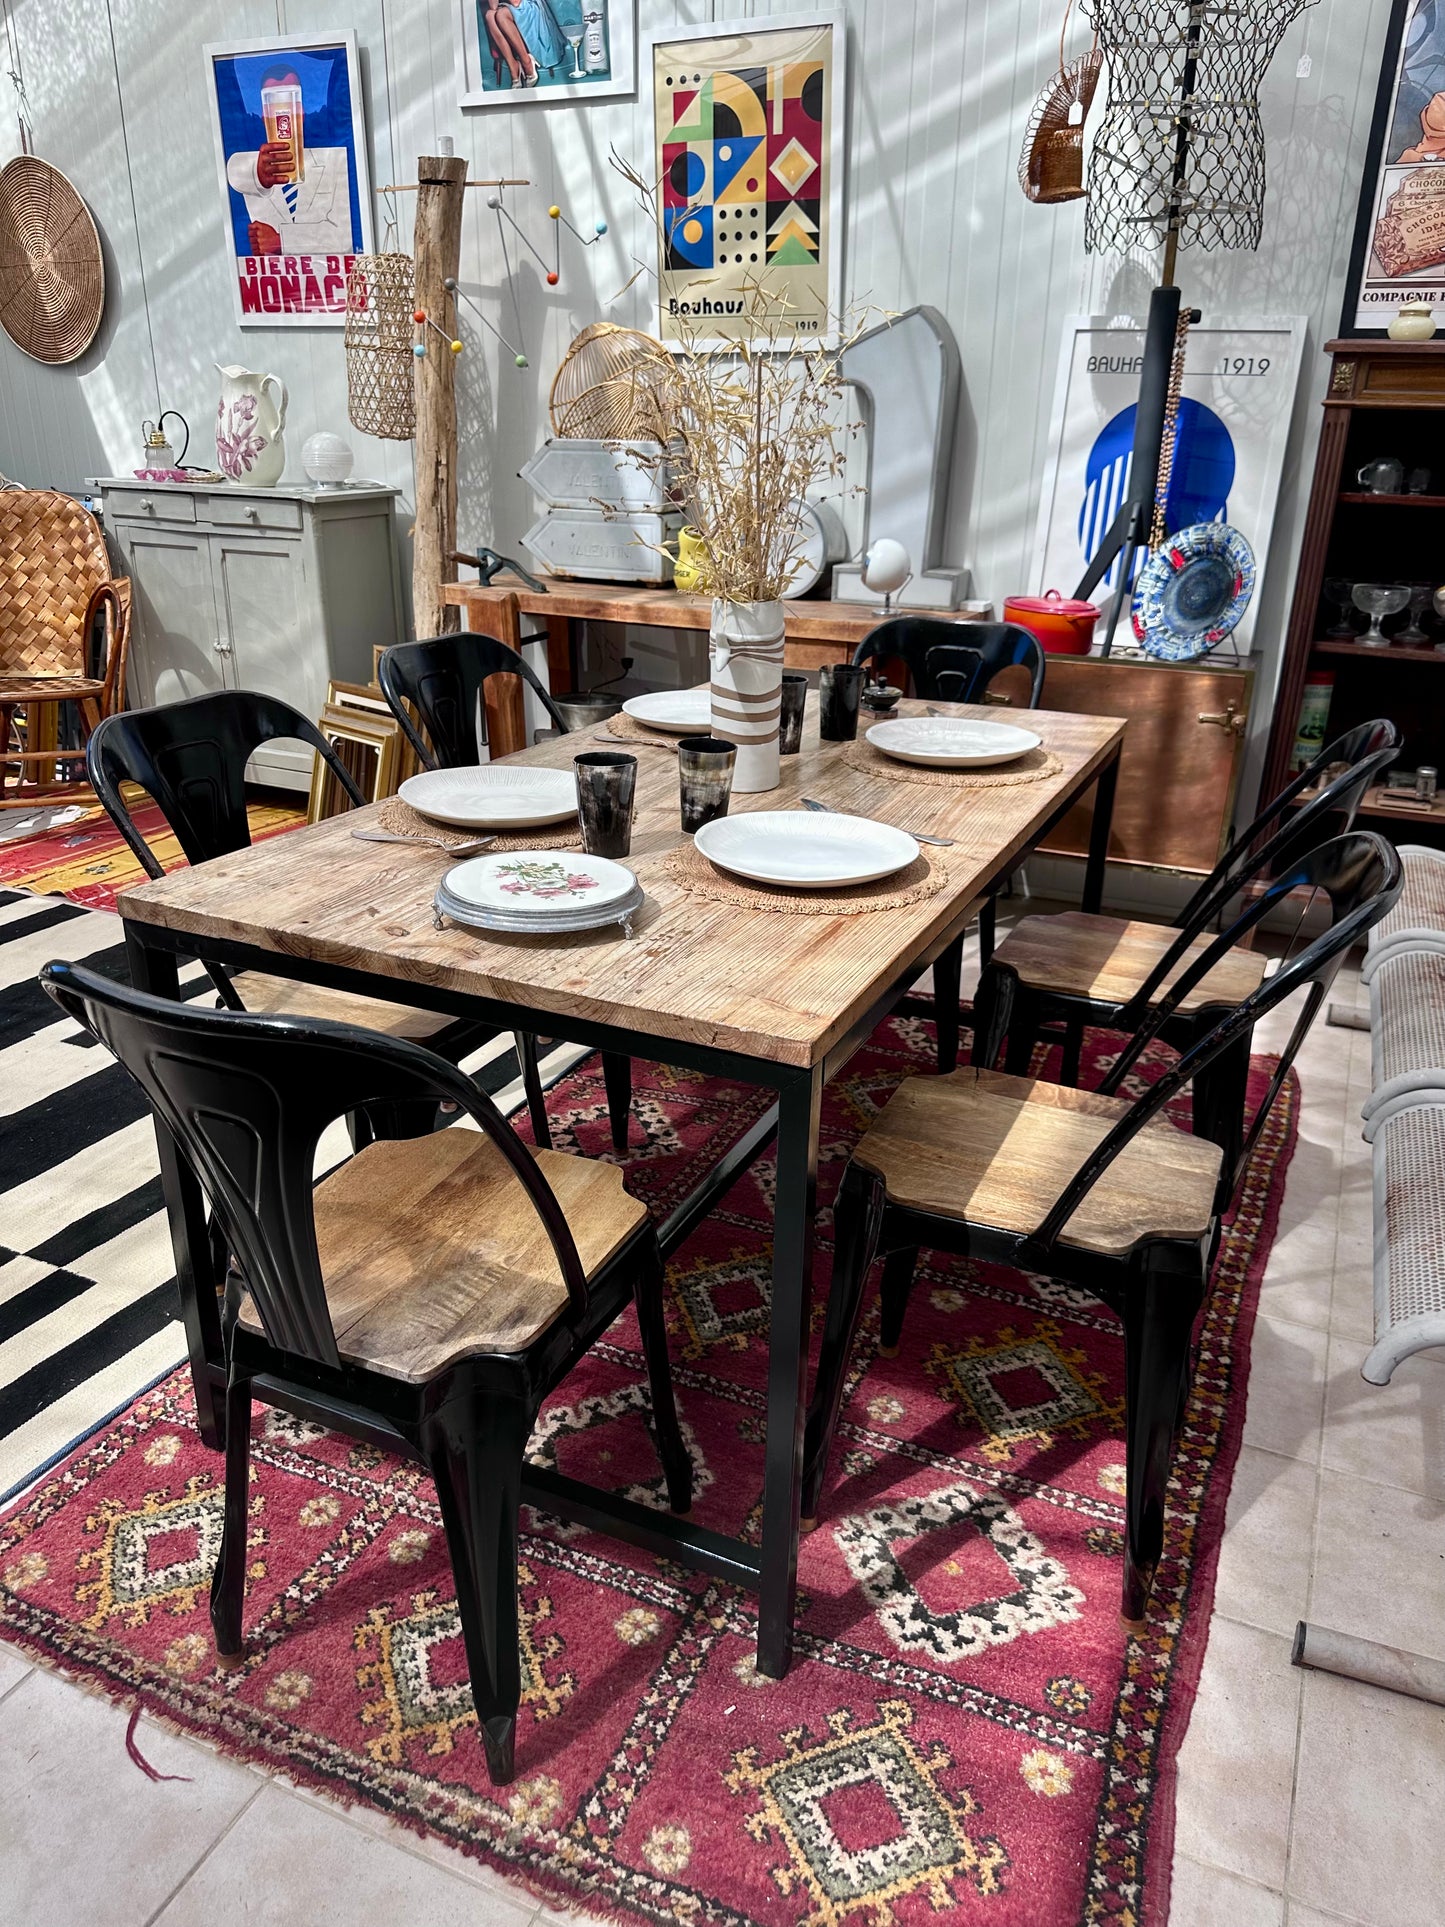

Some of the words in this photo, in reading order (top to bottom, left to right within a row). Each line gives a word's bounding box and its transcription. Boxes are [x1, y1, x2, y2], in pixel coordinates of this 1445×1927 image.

[245, 256, 314, 275] BIERE
[326, 255, 357, 275] DE
[240, 274, 369, 314] MONACO
[1362, 291, 1437, 303] COMPAGNIE
[669, 297, 744, 315] Bauhaus
[795, 321, 818, 331] 1919
[1087, 356, 1144, 372] BAUHA
[1222, 358, 1271, 375] 1919
